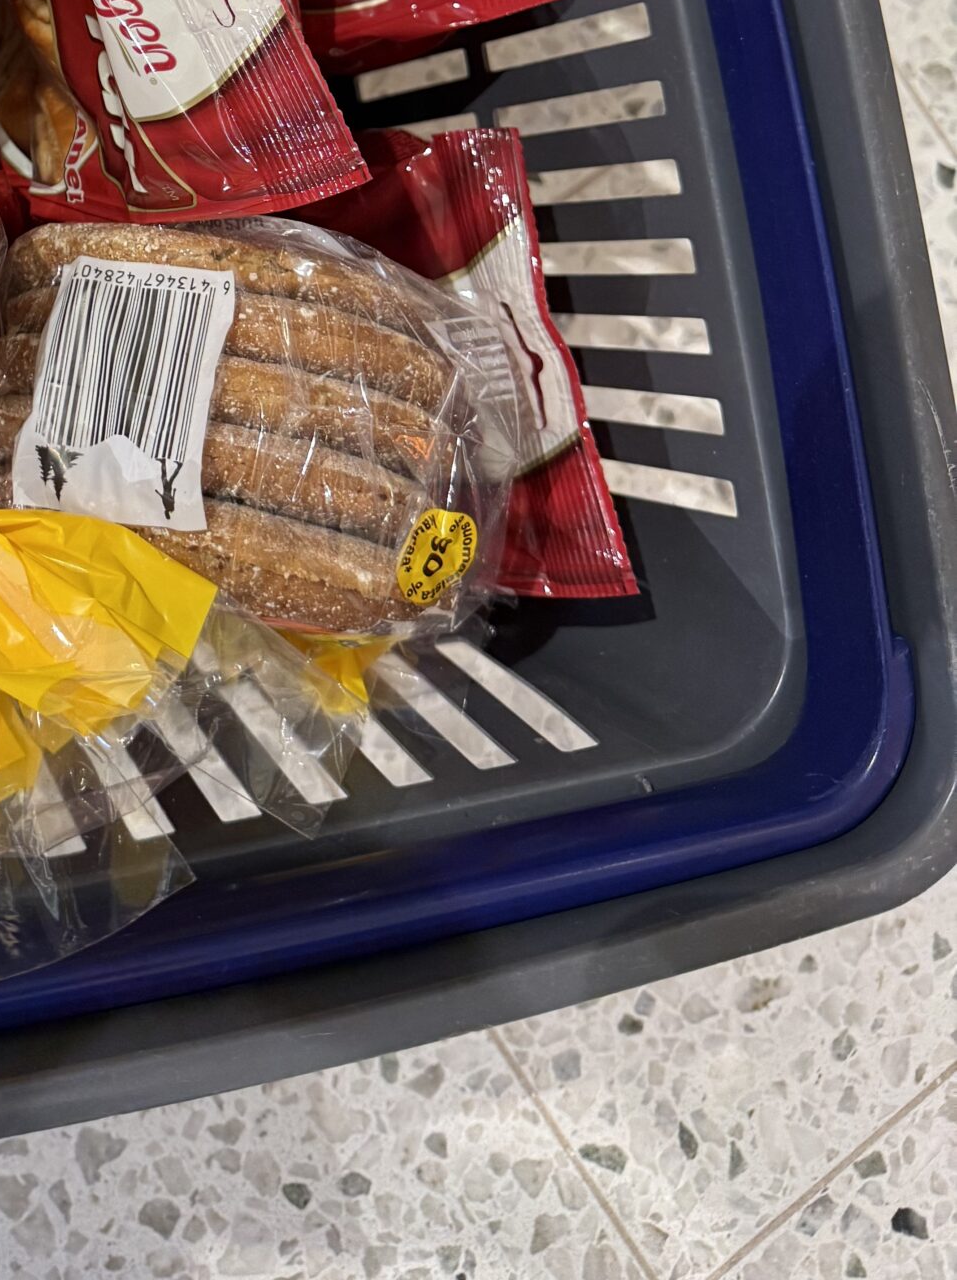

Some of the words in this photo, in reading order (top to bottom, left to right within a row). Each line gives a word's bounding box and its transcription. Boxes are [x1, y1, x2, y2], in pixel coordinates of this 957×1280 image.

[72, 263, 135, 284] 428401
[143, 272, 209, 291] 413467
[222, 279, 231, 294] 6
[406, 582, 423, 598] %
